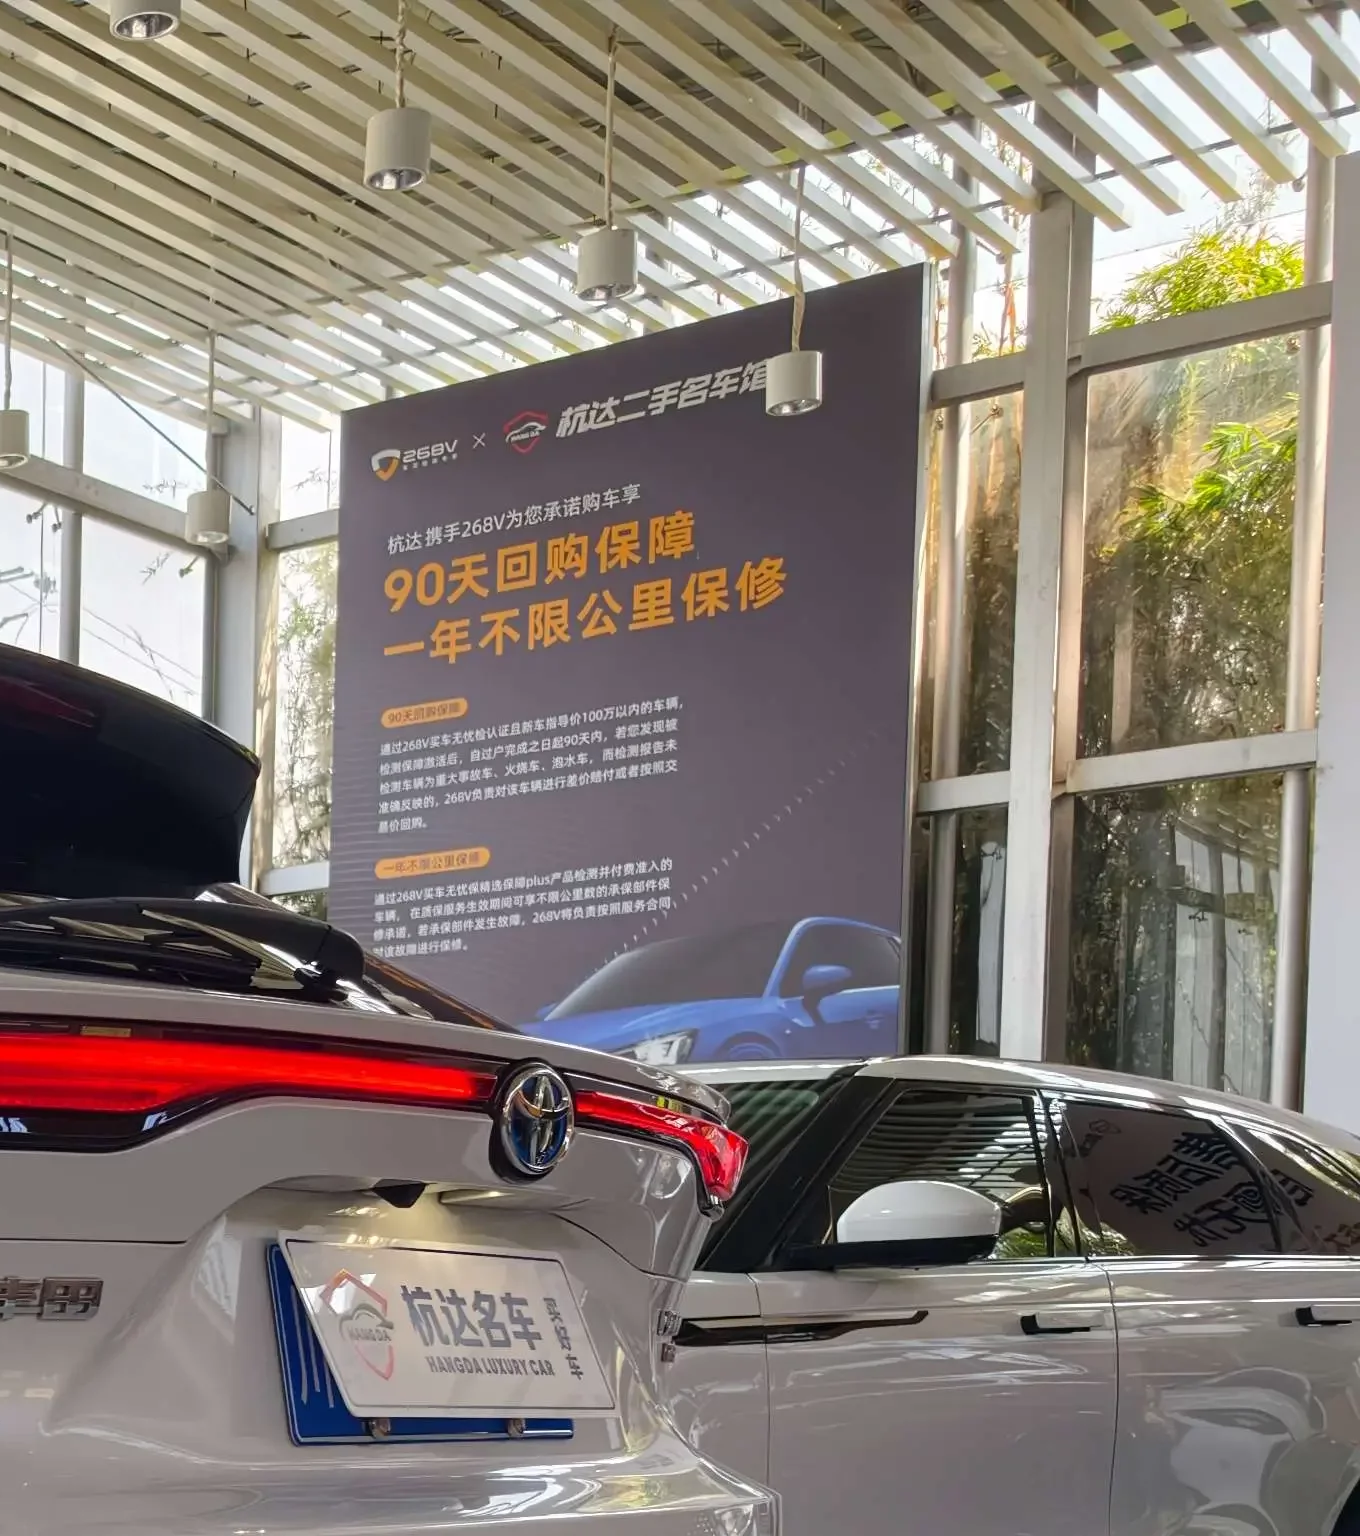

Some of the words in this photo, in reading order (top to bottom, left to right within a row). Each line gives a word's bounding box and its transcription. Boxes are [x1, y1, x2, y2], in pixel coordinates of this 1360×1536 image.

[402, 439, 458, 464] 268V
[555, 358, 767, 439] 杭达二手名车馆
[383, 556, 788, 665] 一年不限公里保修
[384, 509, 696, 612] 90天回购保障
[400, 1285, 542, 1351] 杭达名车
[481, 1357, 529, 1376] LUXURY
[530, 1359, 555, 1377] CAR
